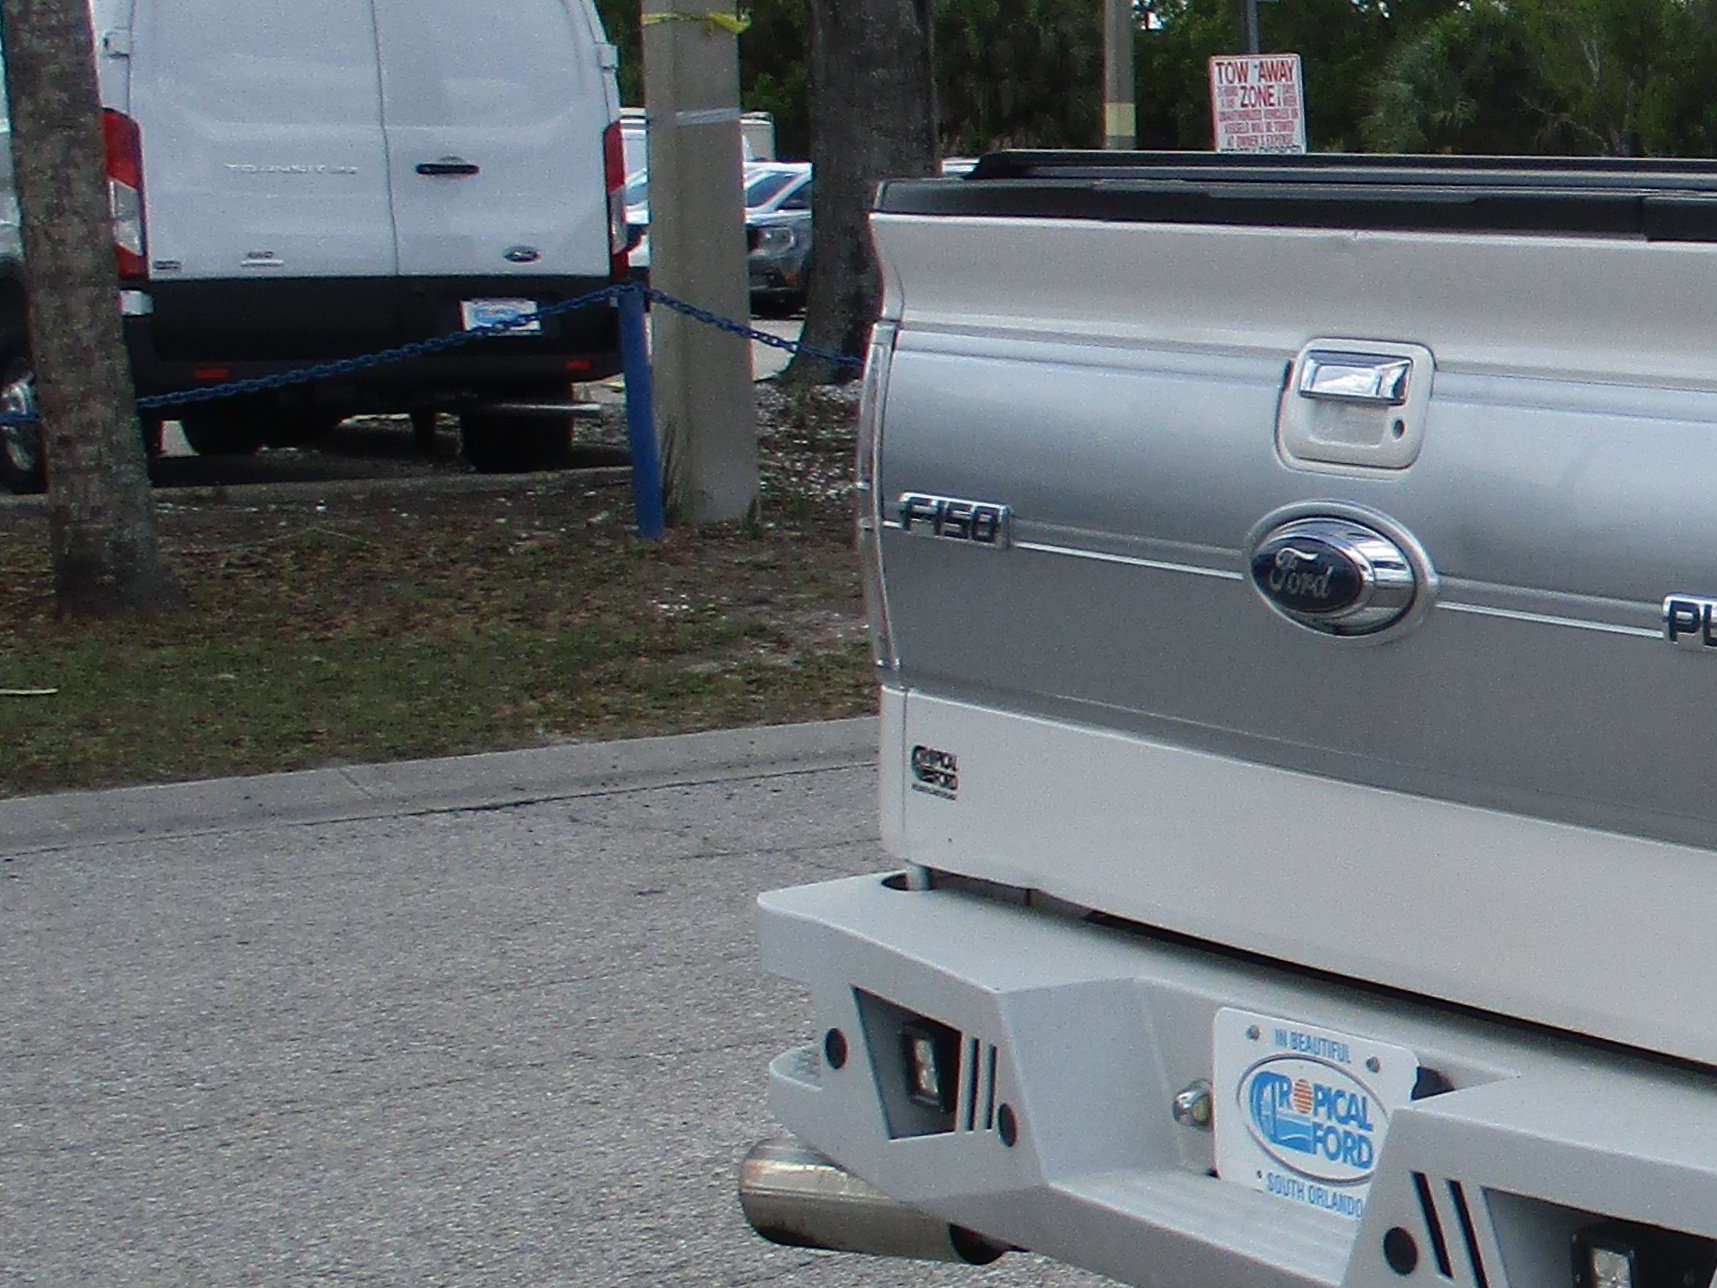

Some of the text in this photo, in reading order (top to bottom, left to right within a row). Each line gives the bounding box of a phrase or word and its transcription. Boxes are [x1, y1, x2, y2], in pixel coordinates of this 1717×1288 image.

[1215, 60, 1295, 84] TOW AWAY
[1240, 84, 1275, 107] ZONE
[1269, 547, 1335, 599] Ford
[1274, 1028, 1352, 1064] IN BEAUTIFUL
[1250, 1070, 1375, 1140] TROPICAL
[1312, 1120, 1374, 1169] FORD
[1267, 1172, 1363, 1218] SOUTH ORLANDO
